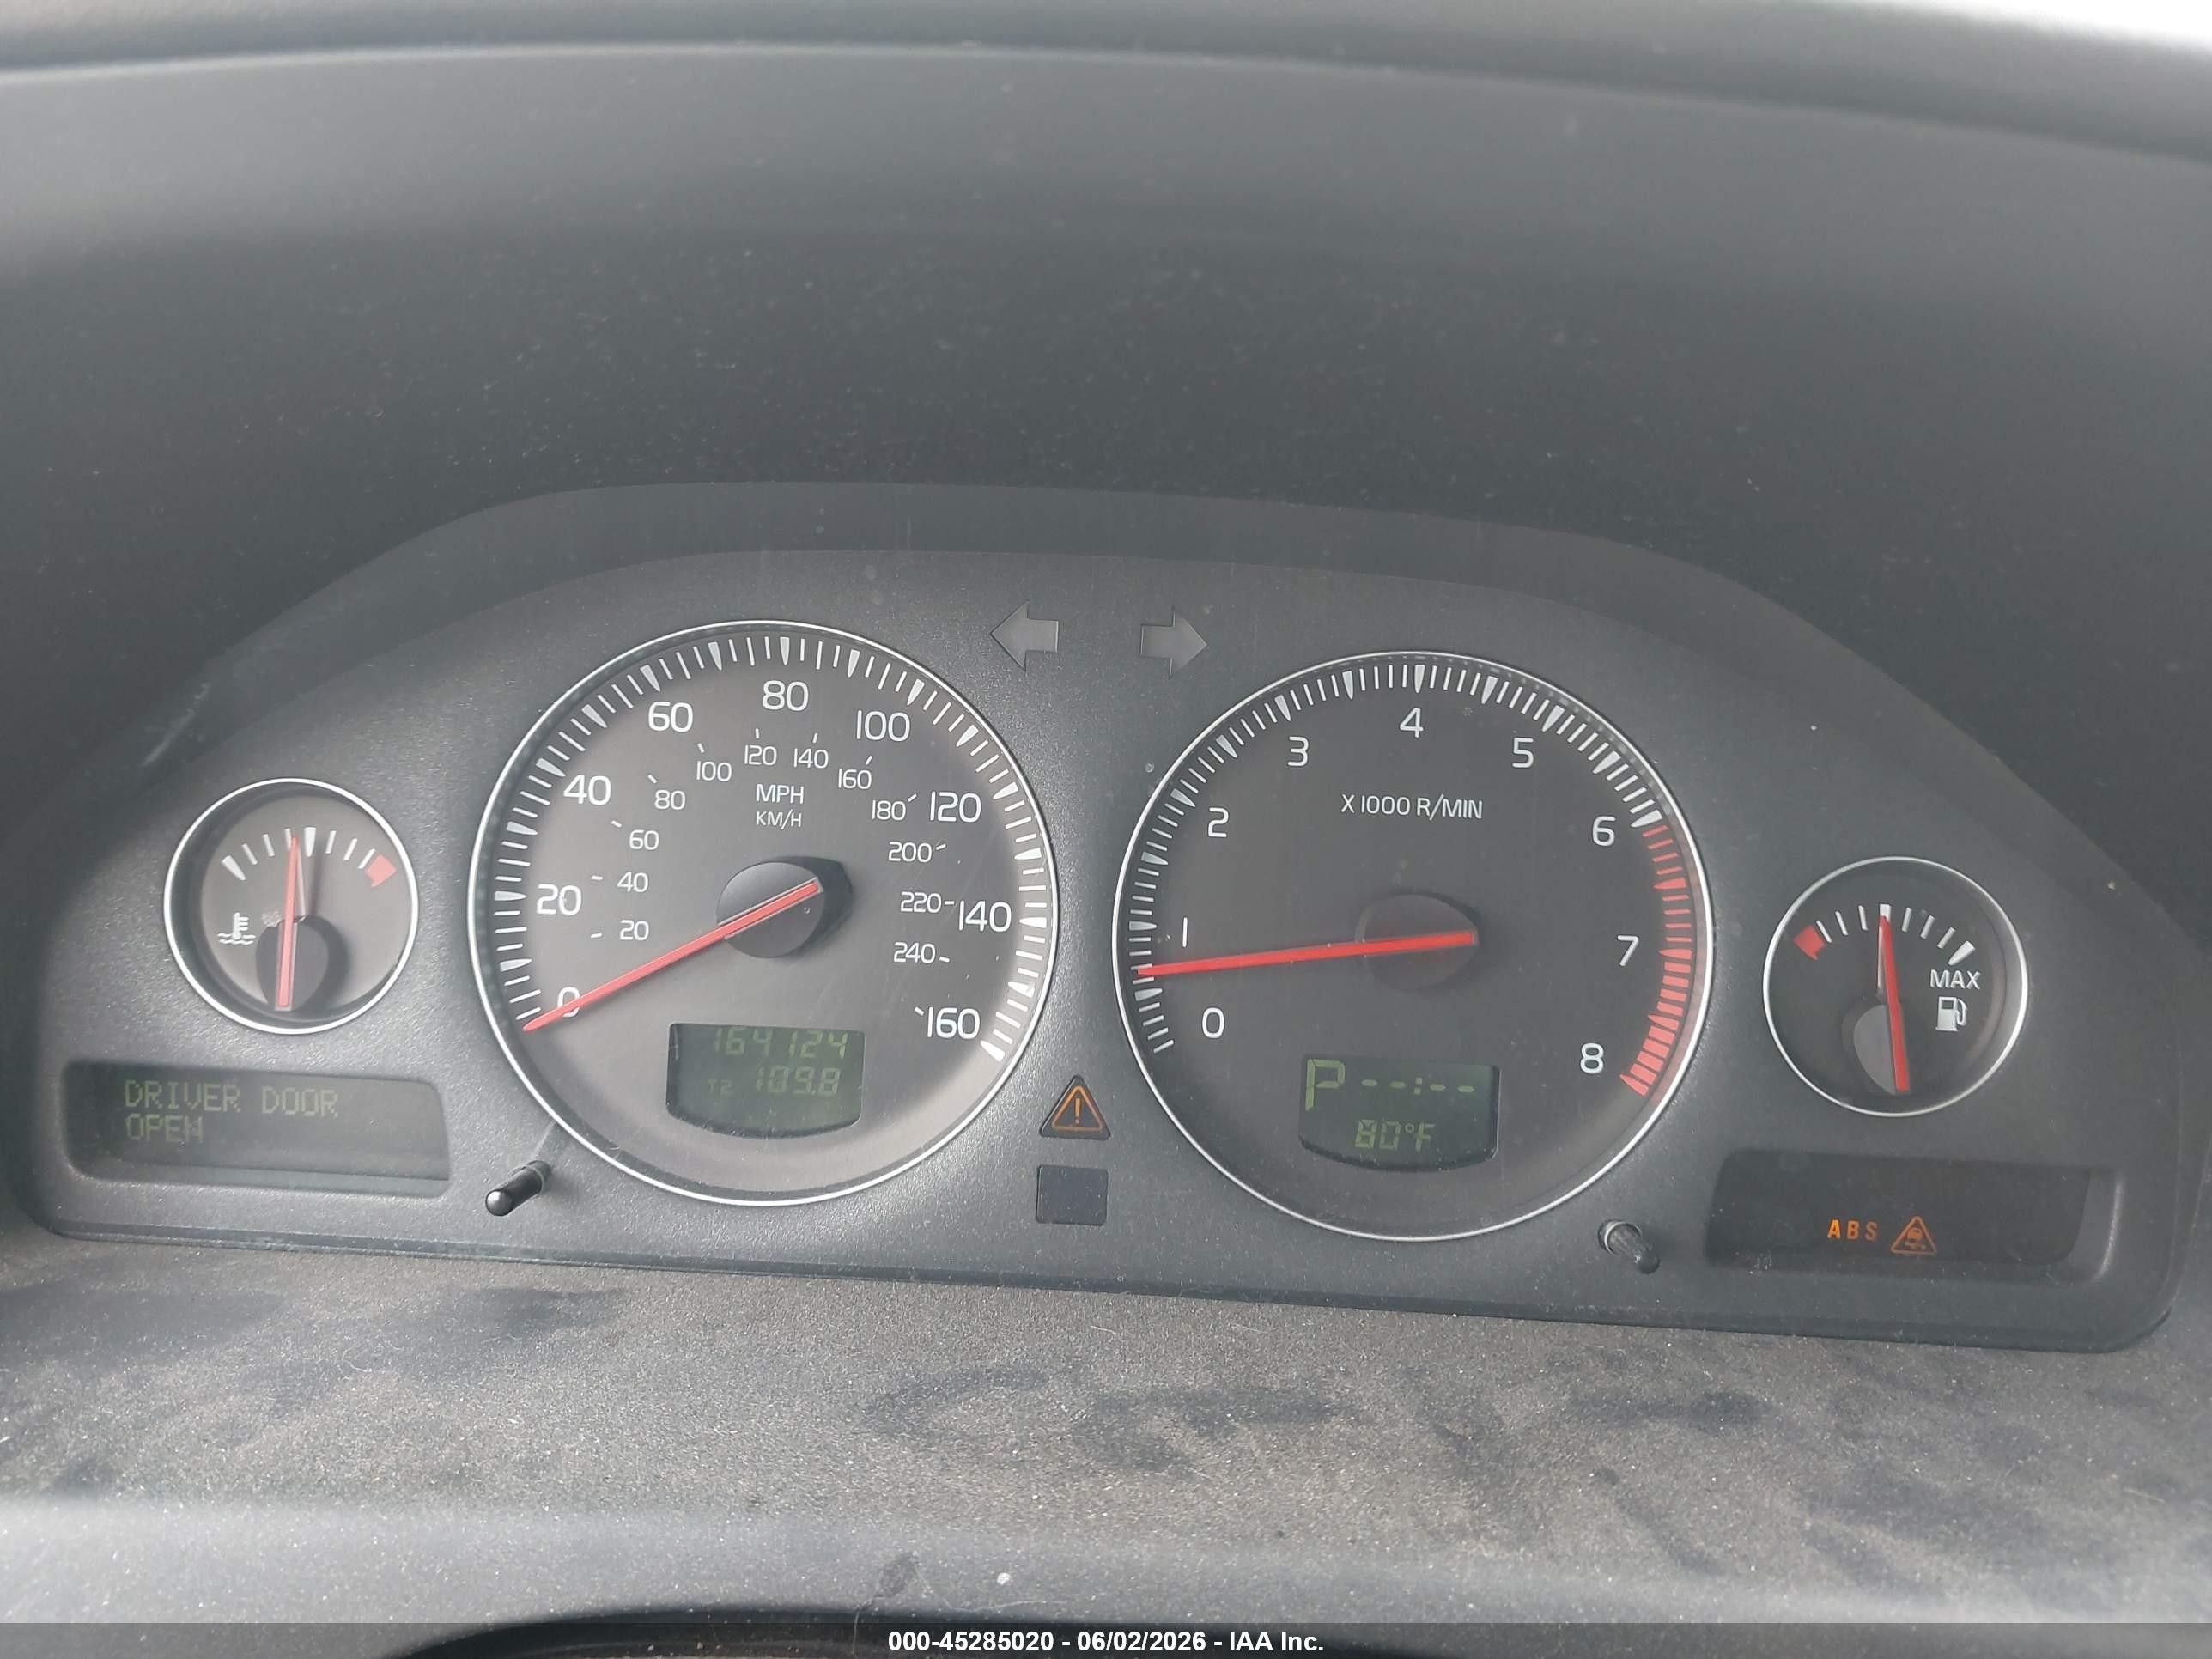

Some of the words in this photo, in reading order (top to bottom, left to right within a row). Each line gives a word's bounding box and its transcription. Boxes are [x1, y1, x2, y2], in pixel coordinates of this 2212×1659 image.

[762, 680, 809, 711] 80
[648, 702, 693, 732] 60
[856, 710, 910, 742] 100
[1400, 708, 1425, 738] 4
[744, 745, 776, 766] 120
[793, 749, 829, 769] 140
[1287, 737, 1310, 767] 3
[1511, 738, 1534, 768] 5
[696, 762, 732, 781] 100
[837, 769, 872, 789] 160
[563, 775, 611, 805] 40
[654, 790, 686, 810] 80
[756, 784, 804, 804] MPH
[756, 810, 802, 830] KM/H
[871, 799, 906, 820] 180
[929, 792, 981, 823] 120
[1207, 807, 1229, 837] 2
[1340, 795, 1355, 812] X
[1360, 795, 1411, 816] 1000
[1416, 794, 1483, 821] R/MIN
[629, 830, 659, 850] 60
[1591, 816, 1615, 846] 6
[888, 842, 932, 862] 200
[617, 872, 648, 892] 40
[537, 884, 581, 915] 20
[900, 892, 942, 914] 220
[619, 920, 649, 940] 20
[957, 900, 1012, 931] 140
[893, 943, 936, 963] 240
[1616, 935, 1638, 966] 7
[1929, 969, 1980, 989] MAX
[926, 1008, 980, 1039] 160
[1201, 1008, 1224, 1038] 0
[714, 1030, 847, 1058] 164124
[1580, 1043, 1604, 1073] 8
[125, 1080, 241, 1111] DRIVER
[262, 1087, 339, 1117] DOOR
[1305, 1058, 1346, 1110] P
[125, 1114, 203, 1143] OPEN
[1827, 1218, 1877, 1240] ABS
